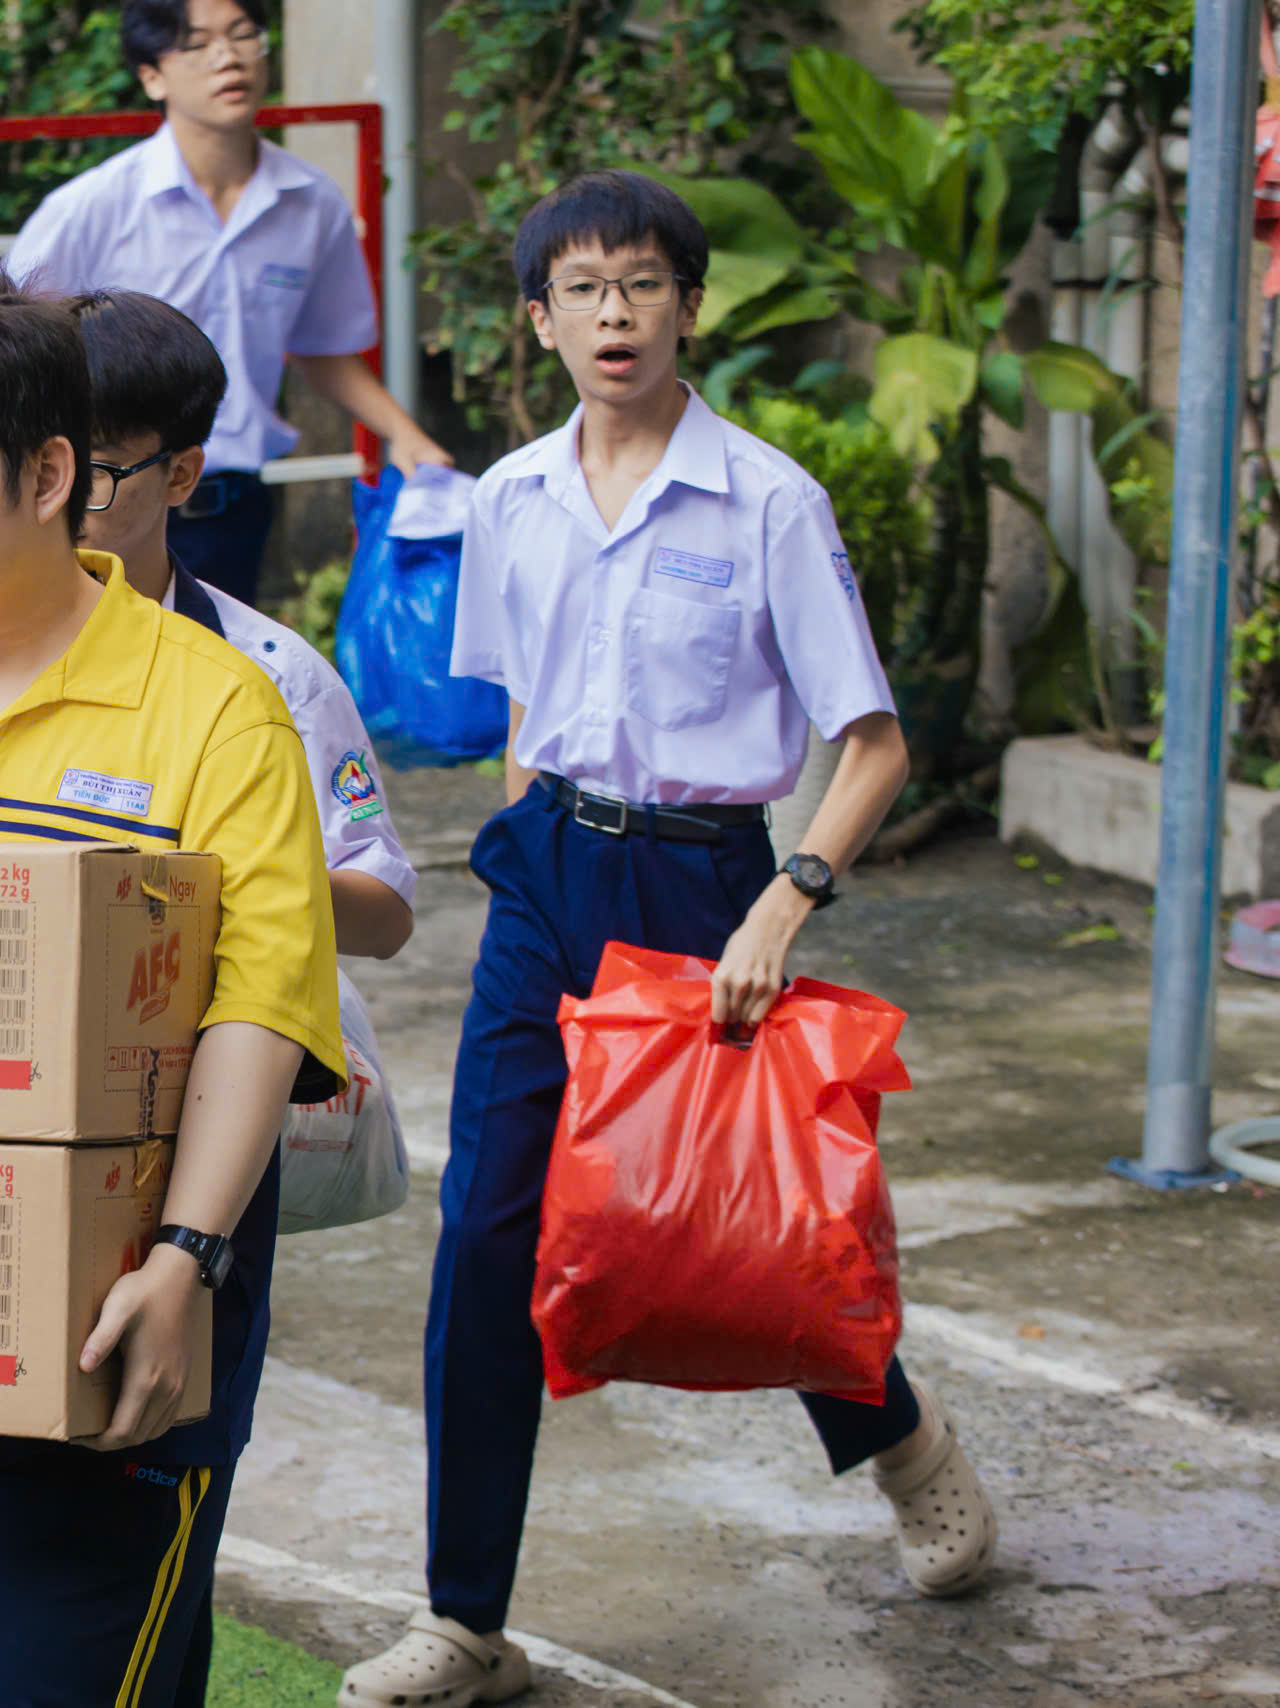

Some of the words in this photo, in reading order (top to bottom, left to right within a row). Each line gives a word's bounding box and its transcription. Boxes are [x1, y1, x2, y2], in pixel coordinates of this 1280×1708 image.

[13, 863, 30, 885] kg
[21, 886, 30, 901] g
[170, 875, 196, 902] Ngay
[127, 931, 180, 1011] AFC
[5, 1182, 13, 1197] g
